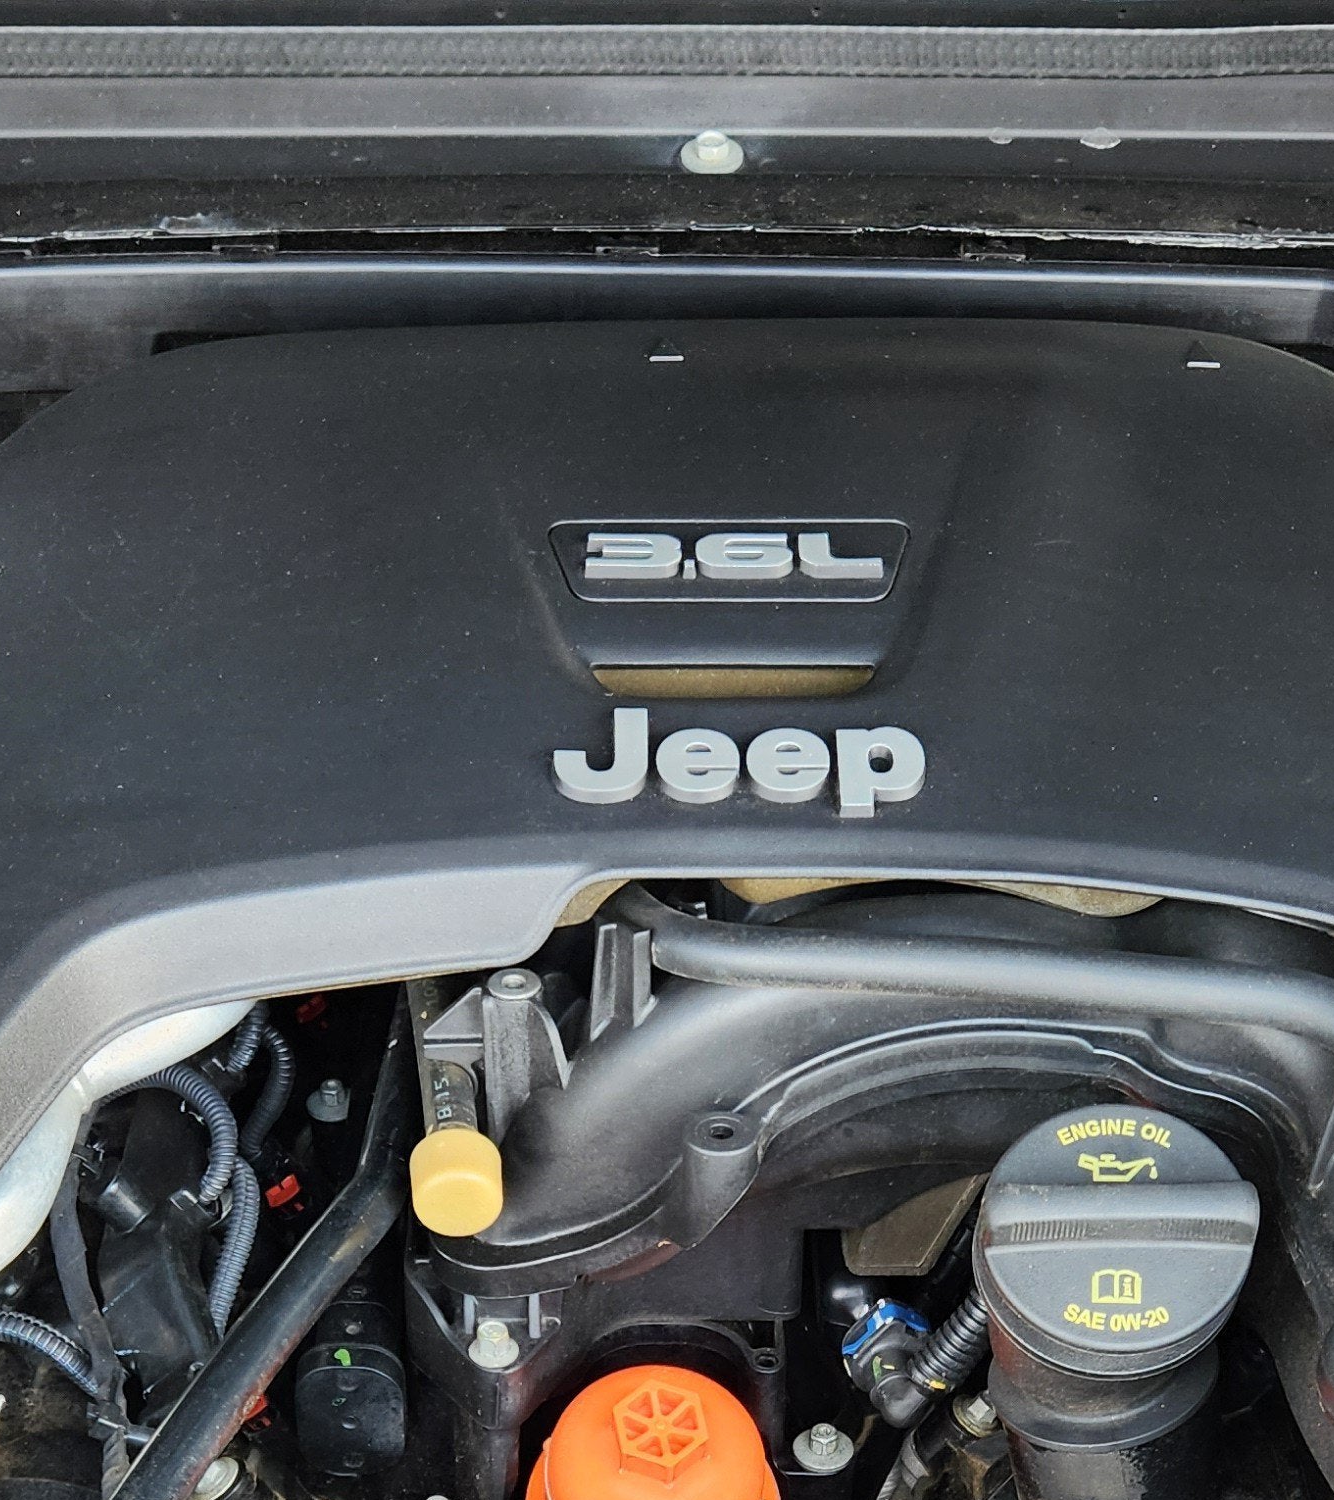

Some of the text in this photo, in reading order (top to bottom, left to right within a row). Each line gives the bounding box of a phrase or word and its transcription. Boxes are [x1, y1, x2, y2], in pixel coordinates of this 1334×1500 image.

[584, 532, 884, 580] 3.6L
[553, 707, 926, 818] Jeep
[1056, 1117, 1172, 1149] ENGINE OIL
[1063, 1302, 1170, 1332] SAE 0W-20
